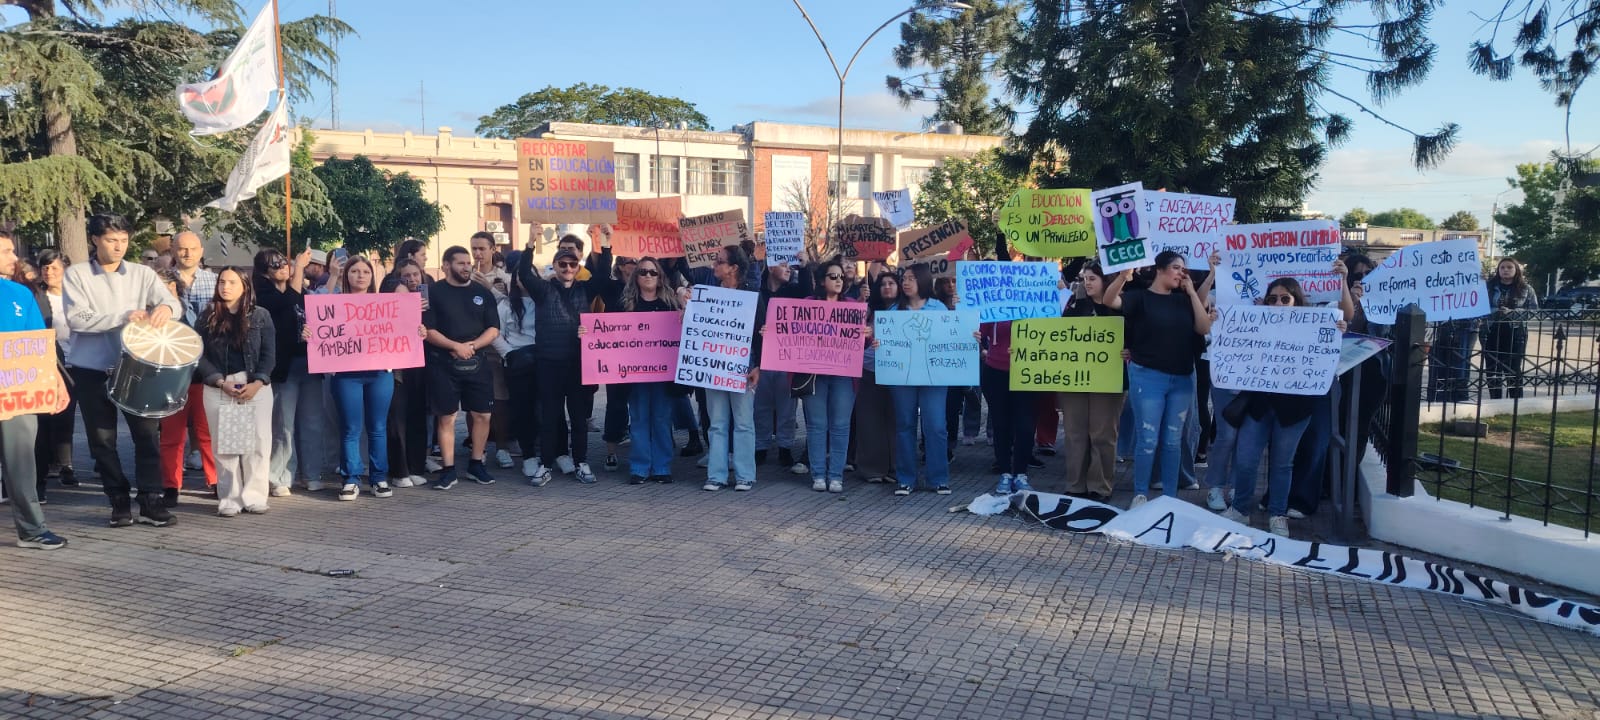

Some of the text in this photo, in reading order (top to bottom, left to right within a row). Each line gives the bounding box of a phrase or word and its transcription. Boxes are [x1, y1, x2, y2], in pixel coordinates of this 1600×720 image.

[521, 142, 587, 157] RECORTAR
[529, 155, 615, 174] EN EDUCACIÓN
[530, 177, 615, 192] ES SILENCIAR
[527, 197, 566, 210] VOCES
[1007, 210, 1085, 227] ES UN DERECHO
[682, 223, 737, 242] RECORTE
[902, 220, 966, 260] PRESENCIA
[1026, 230, 1040, 242] UN
[686, 243, 696, 252] NI
[1226, 233, 1247, 251] NO
[1110, 244, 1145, 263] CECC
[1230, 253, 1252, 268] 222
[1257, 252, 1298, 268] grupos
[1412, 250, 1423, 267] Si
[1430, 249, 1453, 265] esto
[1458, 250, 1477, 263] era
[1000, 265, 1036, 277] VAMOS
[966, 276, 1014, 291] BRINDAR
[1379, 277, 1417, 294] reforma
[1425, 271, 1481, 288] educativa
[966, 292, 981, 306] SI
[1430, 288, 1479, 312] TÍTULO
[316, 300, 400, 322] UN DOCENTE
[710, 305, 724, 314] EN
[776, 305, 788, 321] DE
[791, 306, 825, 322] TANTO
[1218, 305, 1338, 330] YA NO NOS PUEDEN
[593, 318, 650, 333] Ahorrar en
[692, 313, 745, 330] EDUCACIÓN
[1226, 325, 1259, 334] CALLAR
[317, 321, 394, 339] QUE LUCHA
[686, 327, 752, 343] ES CONSTRUIR
[776, 322, 861, 339] EN EDUCACIÓN NOS
[1017, 322, 1116, 346] Hoy estudiás
[317, 335, 411, 357] TAMBIÉN EDUCA
[685, 339, 749, 358] EL FUTURO
[1273, 340, 1304, 352] HECHOS
[1308, 343, 1320, 354] DE
[779, 348, 791, 361] EN
[1014, 347, 1109, 363] Mañana no
[1214, 351, 1316, 366] SOMOS PRESAS DE
[597, 359, 609, 373] la
[929, 357, 967, 369] FORZADA
[677, 368, 694, 381] ES
[695, 371, 712, 384] UN
[1020, 367, 1071, 386] Sabés
[1216, 373, 1326, 391] NO PUEDEN CALLAR
[1302, 368, 1328, 380] QUE
[1134, 511, 1175, 544] A
